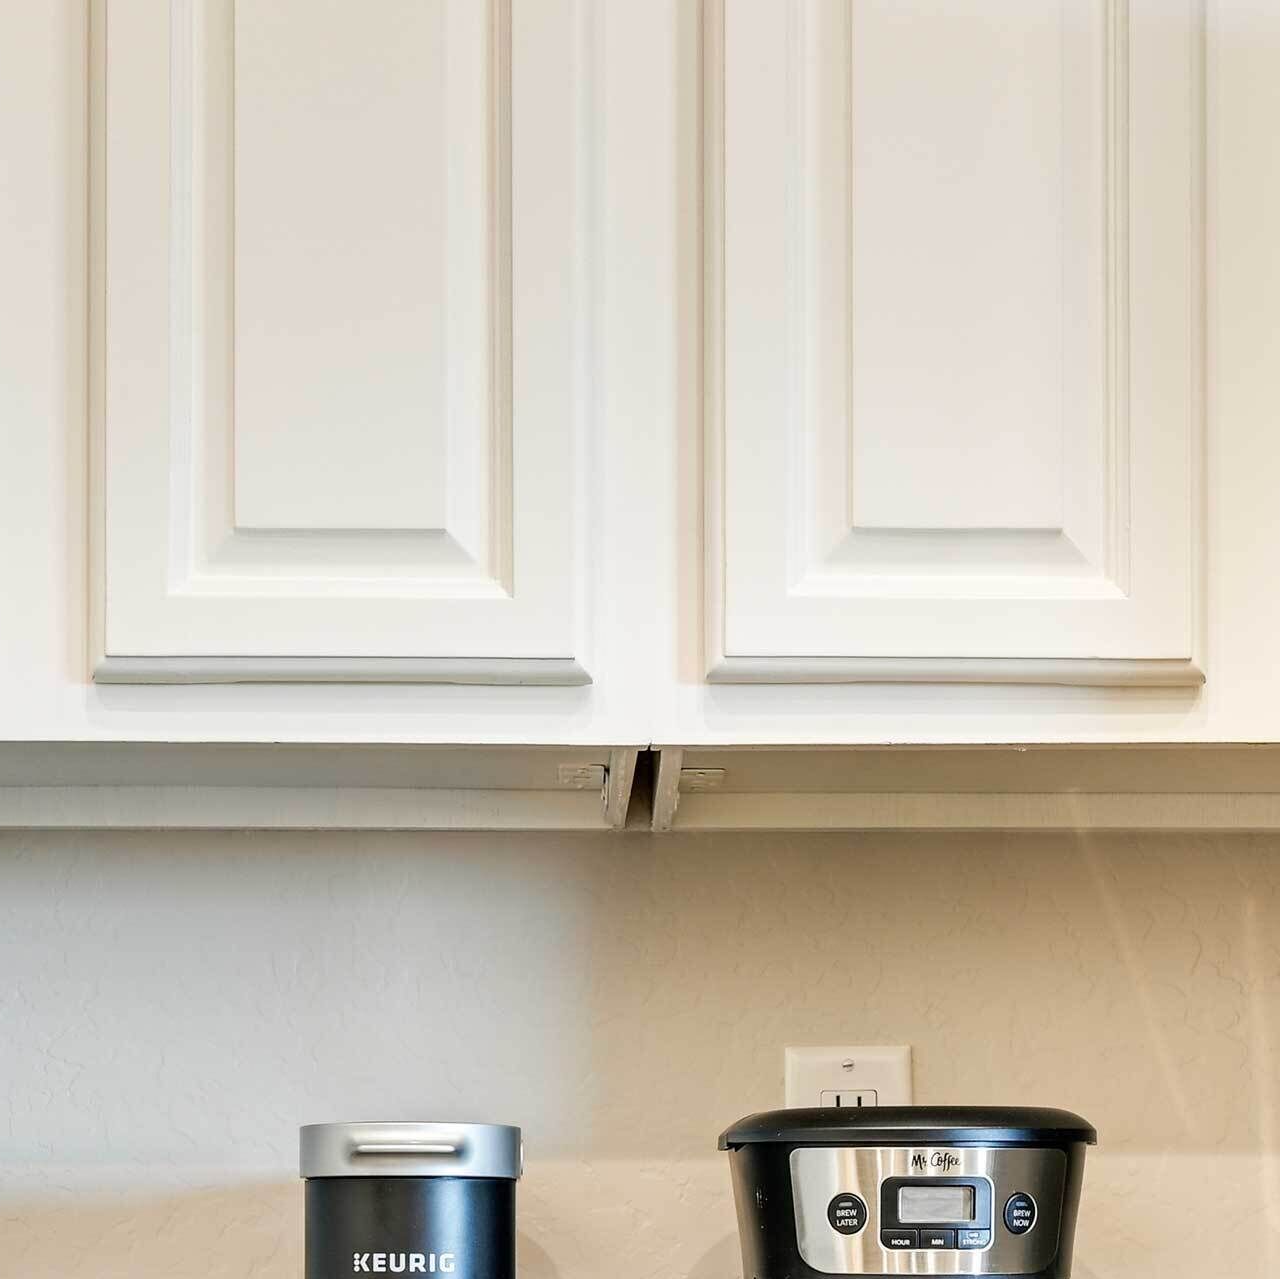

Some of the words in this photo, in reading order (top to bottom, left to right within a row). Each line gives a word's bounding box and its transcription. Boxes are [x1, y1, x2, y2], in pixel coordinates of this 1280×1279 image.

[930, 1152, 961, 1172] Coffee
[836, 1209, 857, 1217] BREW
[1013, 1209, 1031, 1217] BREW
[836, 1219, 858, 1227] LATER
[1013, 1219, 1030, 1227] NOW
[353, 1252, 456, 1273] KEURIG
